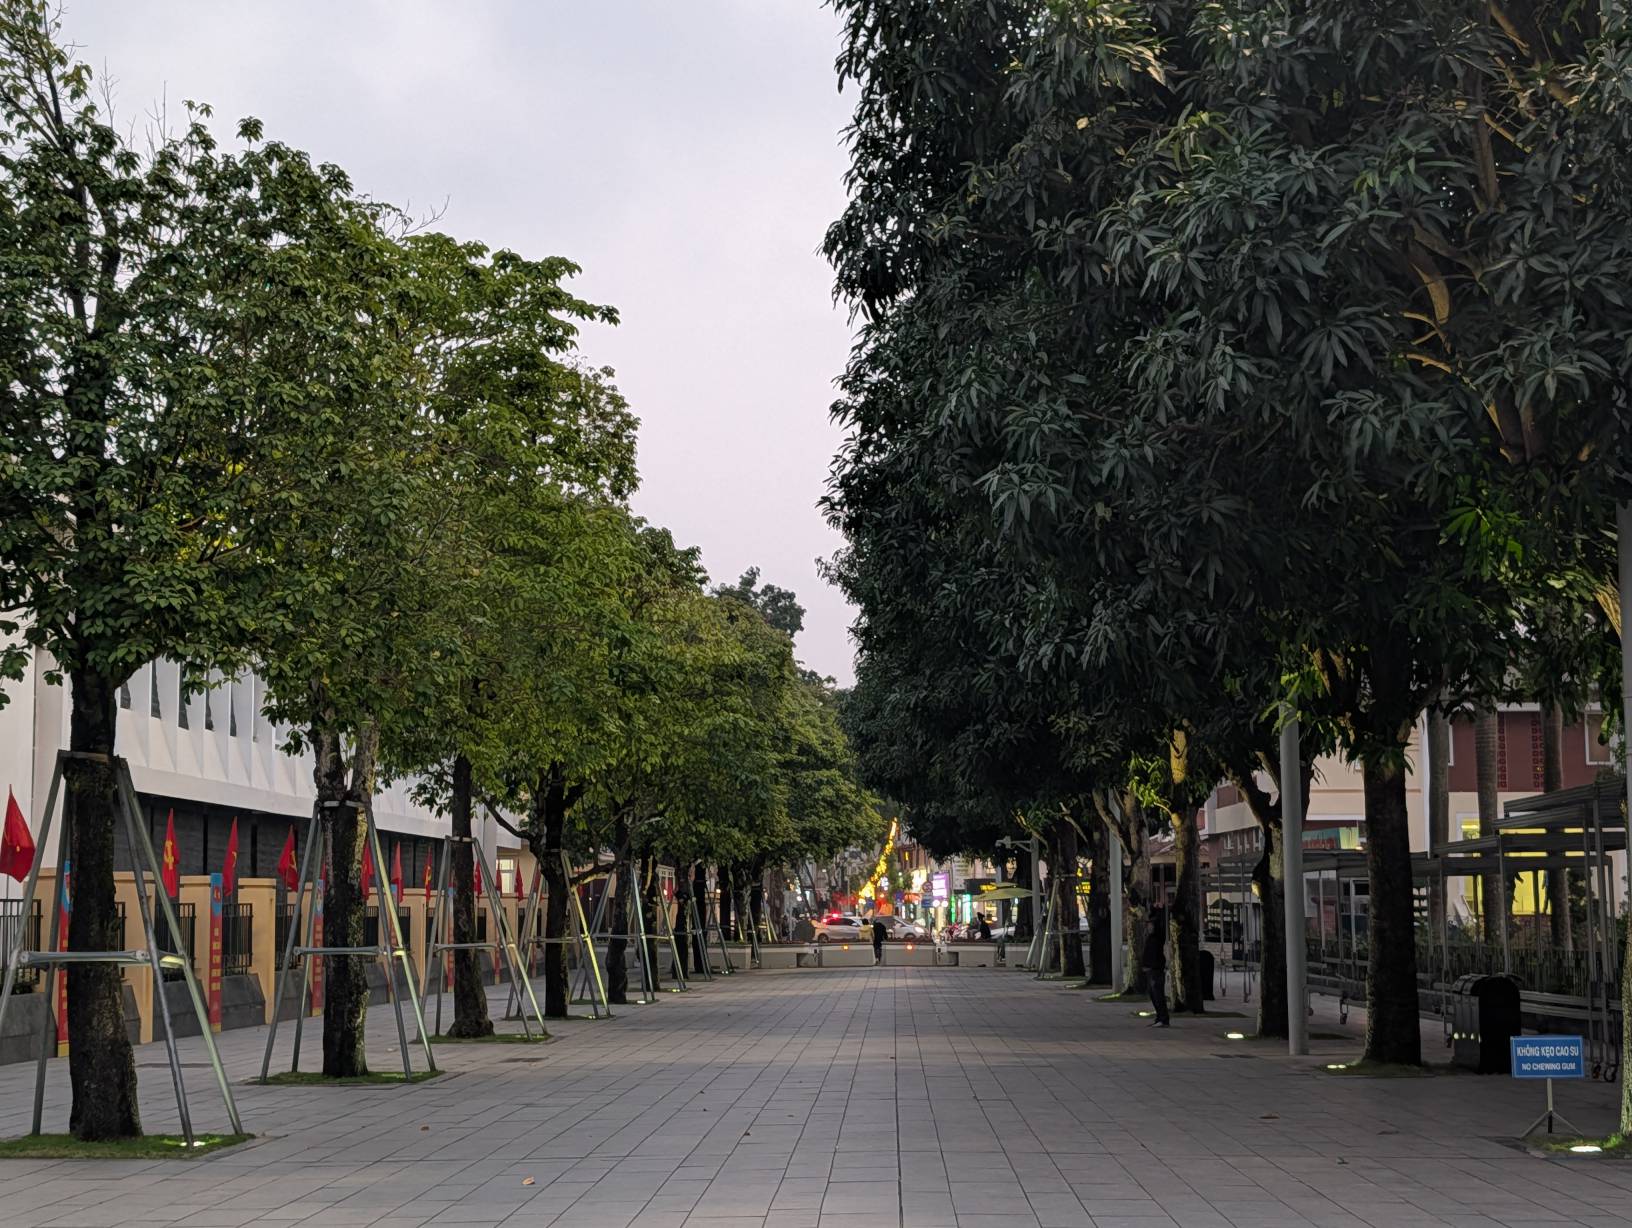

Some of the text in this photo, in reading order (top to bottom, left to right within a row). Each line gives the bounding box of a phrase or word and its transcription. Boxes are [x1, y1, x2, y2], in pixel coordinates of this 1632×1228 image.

[1516, 1044, 1578, 1057] KHÔNG KẸO CAO SU
[1532, 1062, 1561, 1070] CHEWING
[1561, 1062, 1576, 1070] GUM
